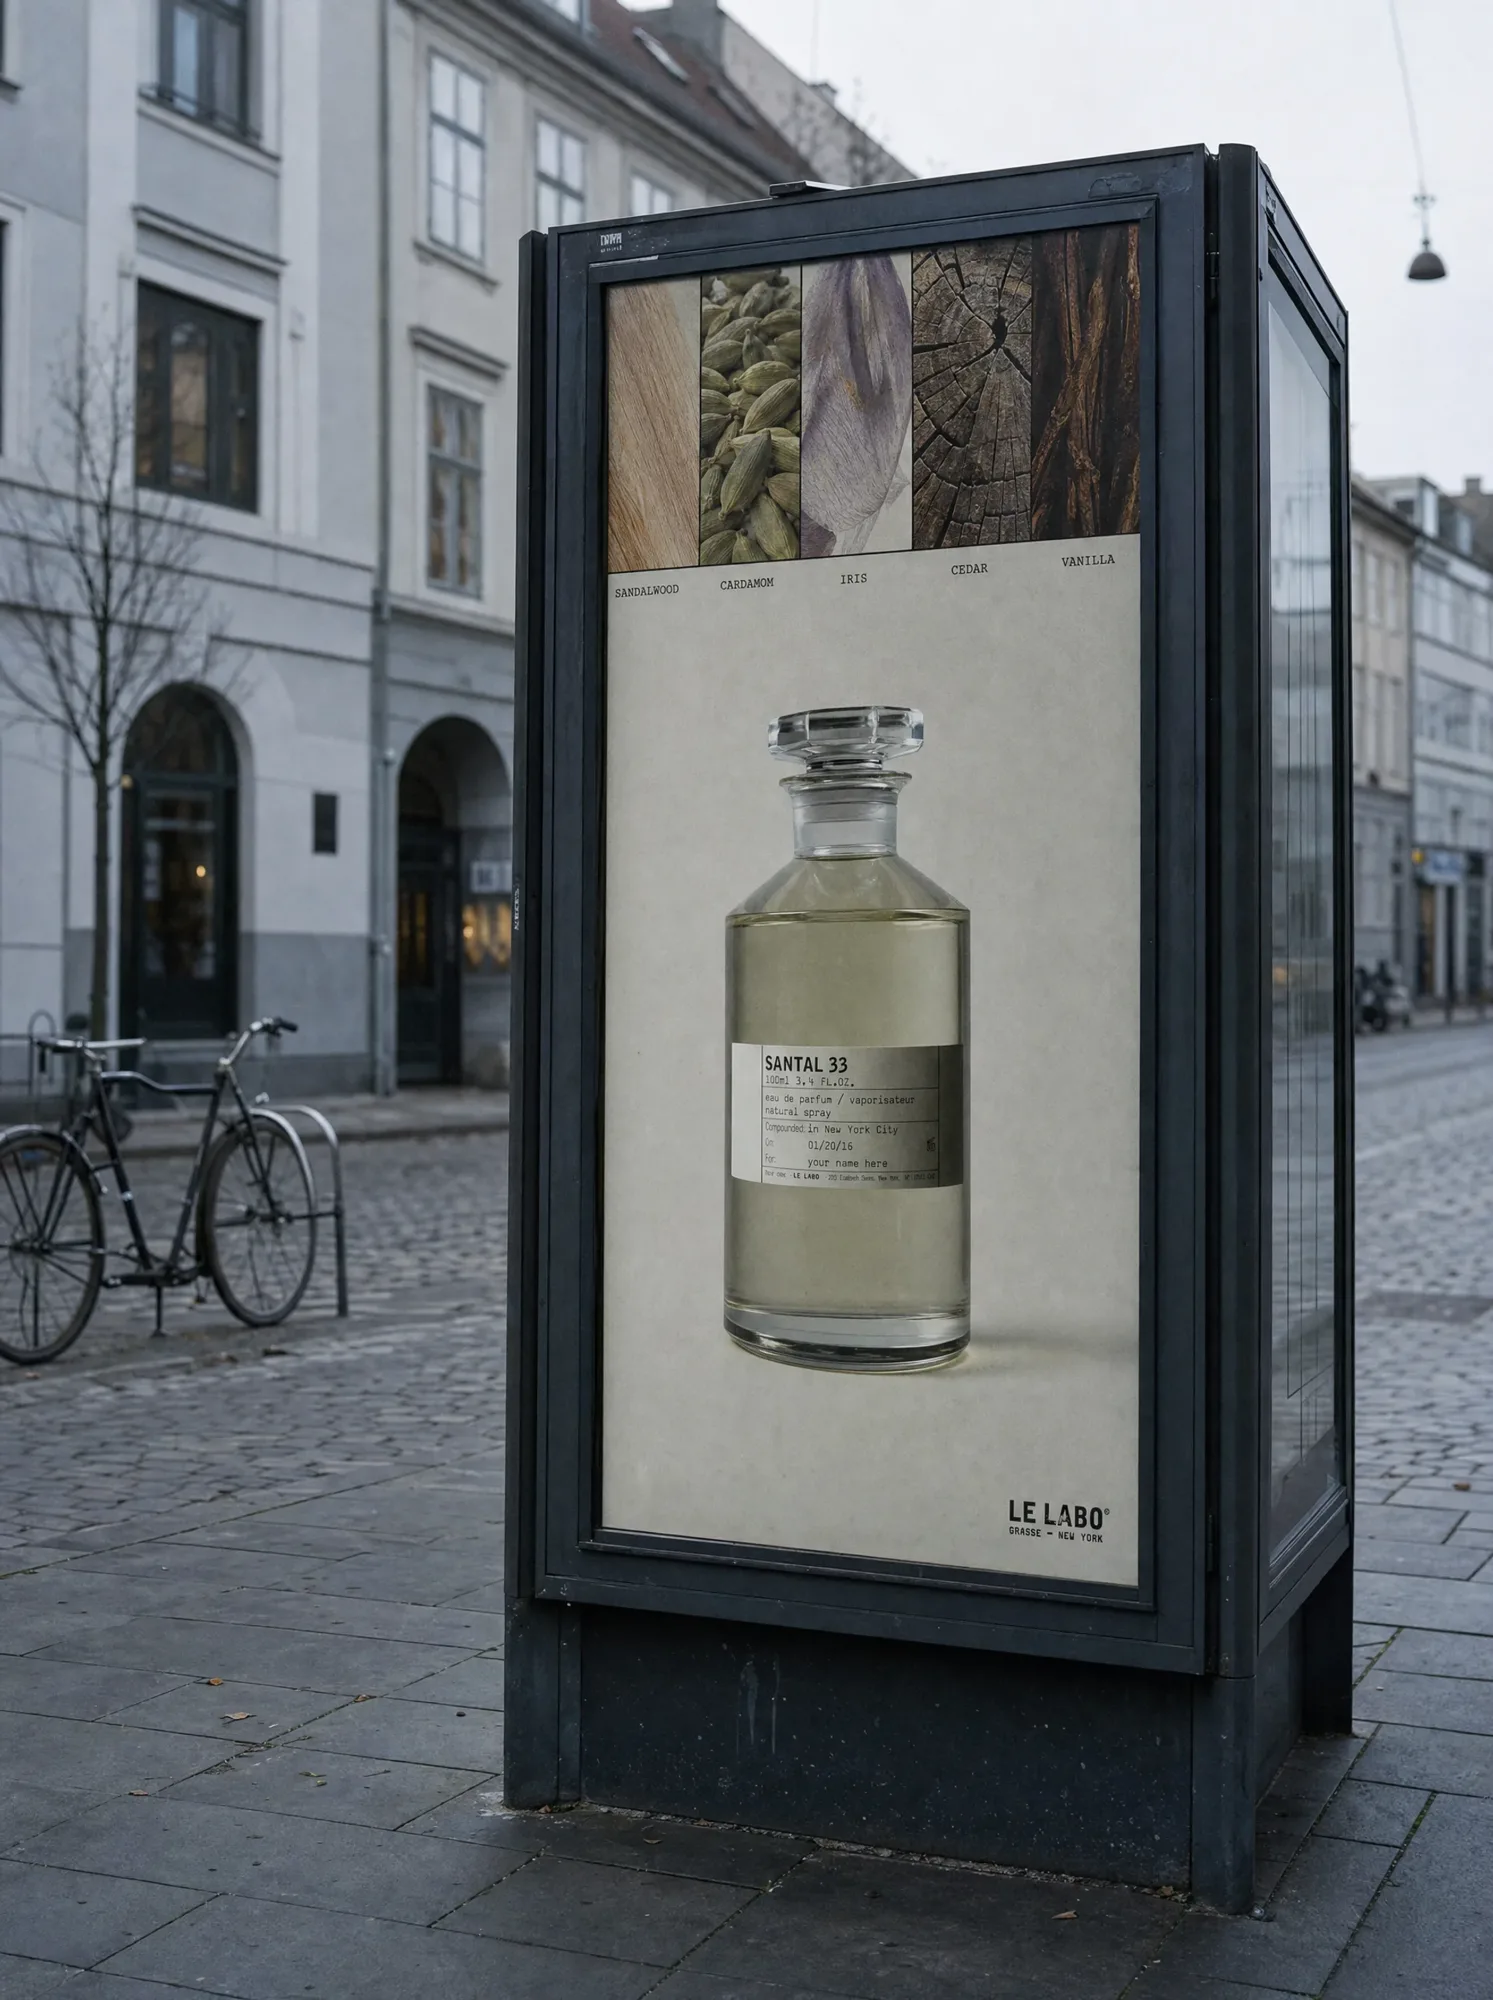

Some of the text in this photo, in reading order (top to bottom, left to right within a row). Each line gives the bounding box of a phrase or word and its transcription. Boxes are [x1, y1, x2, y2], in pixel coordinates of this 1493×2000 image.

[1061, 554, 1116, 567] VANILLA
[951, 563, 988, 575] CEDAR
[720, 577, 774, 590] CARDAMOM
[840, 573, 868, 585] IRIS
[615, 584, 680, 598] SANDALWOOD
[765, 1055, 848, 1073] SANTAL 33
[765, 1075, 790, 1085] 100ml
[796, 1076, 814, 1086] 3.4
[765, 1094, 779, 1102] eau
[784, 1094, 794, 1103] de
[799, 1094, 832, 1105] parfum
[849, 1095, 915, 1106] vaporisateur
[765, 1107, 832, 1119] natural spray
[808, 1123, 819, 1133] in
[824, 1125, 841, 1133] New
[847, 1125, 870, 1134] York
[876, 1124, 898, 1136] City
[808, 1140, 853, 1151] 01/20/16
[807, 1159, 830, 1168] your
[835, 1160, 859, 1168] name
[864, 1159, 888, 1168] here
[1009, 1500, 1037, 1524] LE
[1008, 1526, 1042, 1537] GRASSE
[1058, 1531, 1075, 1541] NEW
[1080, 1533, 1104, 1543] YORK
